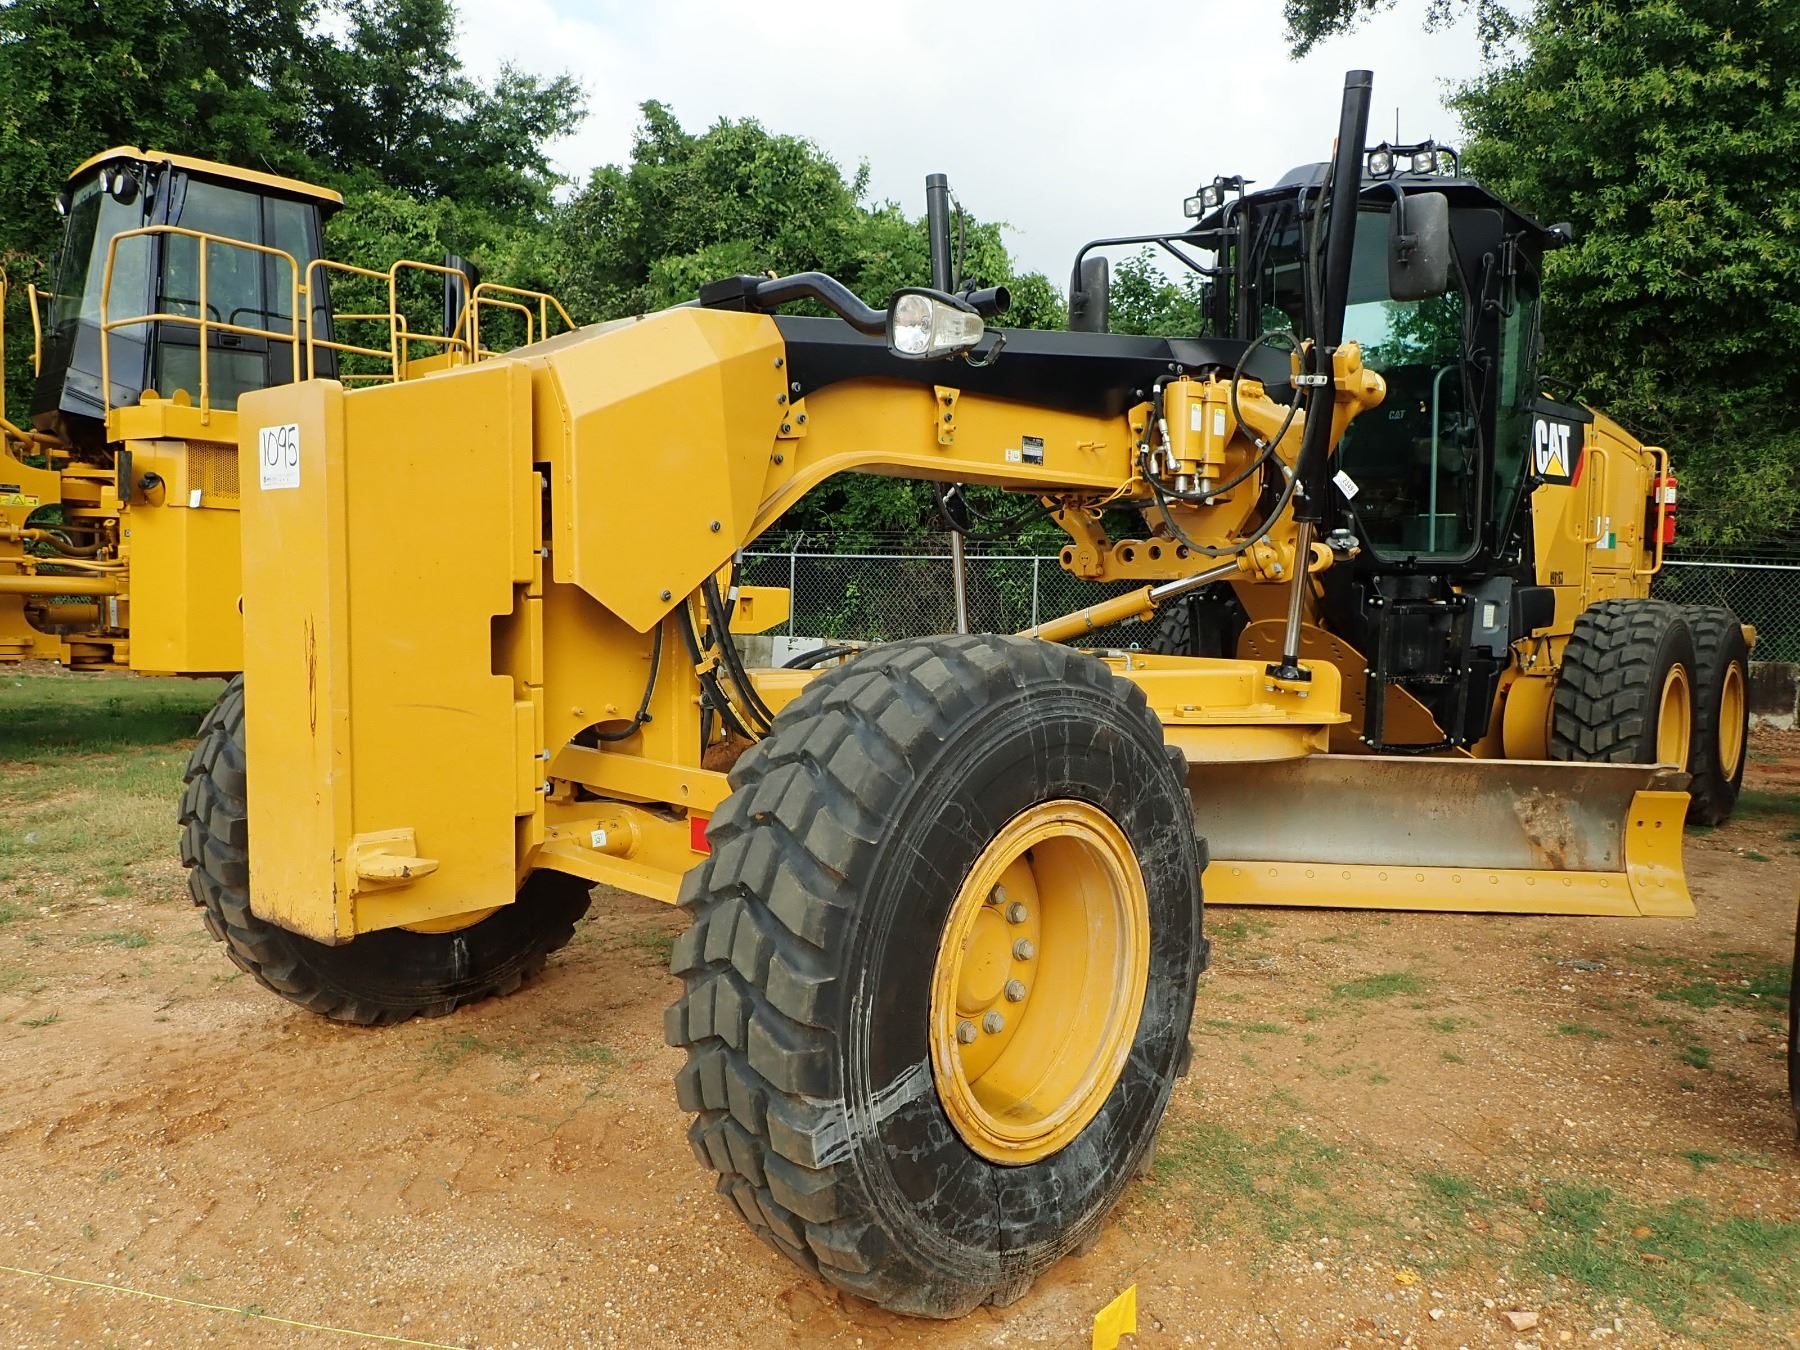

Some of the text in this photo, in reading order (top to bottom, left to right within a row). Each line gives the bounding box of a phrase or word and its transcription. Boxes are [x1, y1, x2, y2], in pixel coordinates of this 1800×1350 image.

[1389, 410, 1405, 420] CAT
[263, 426, 297, 469] 1095
[1535, 420, 1570, 477] CAT
